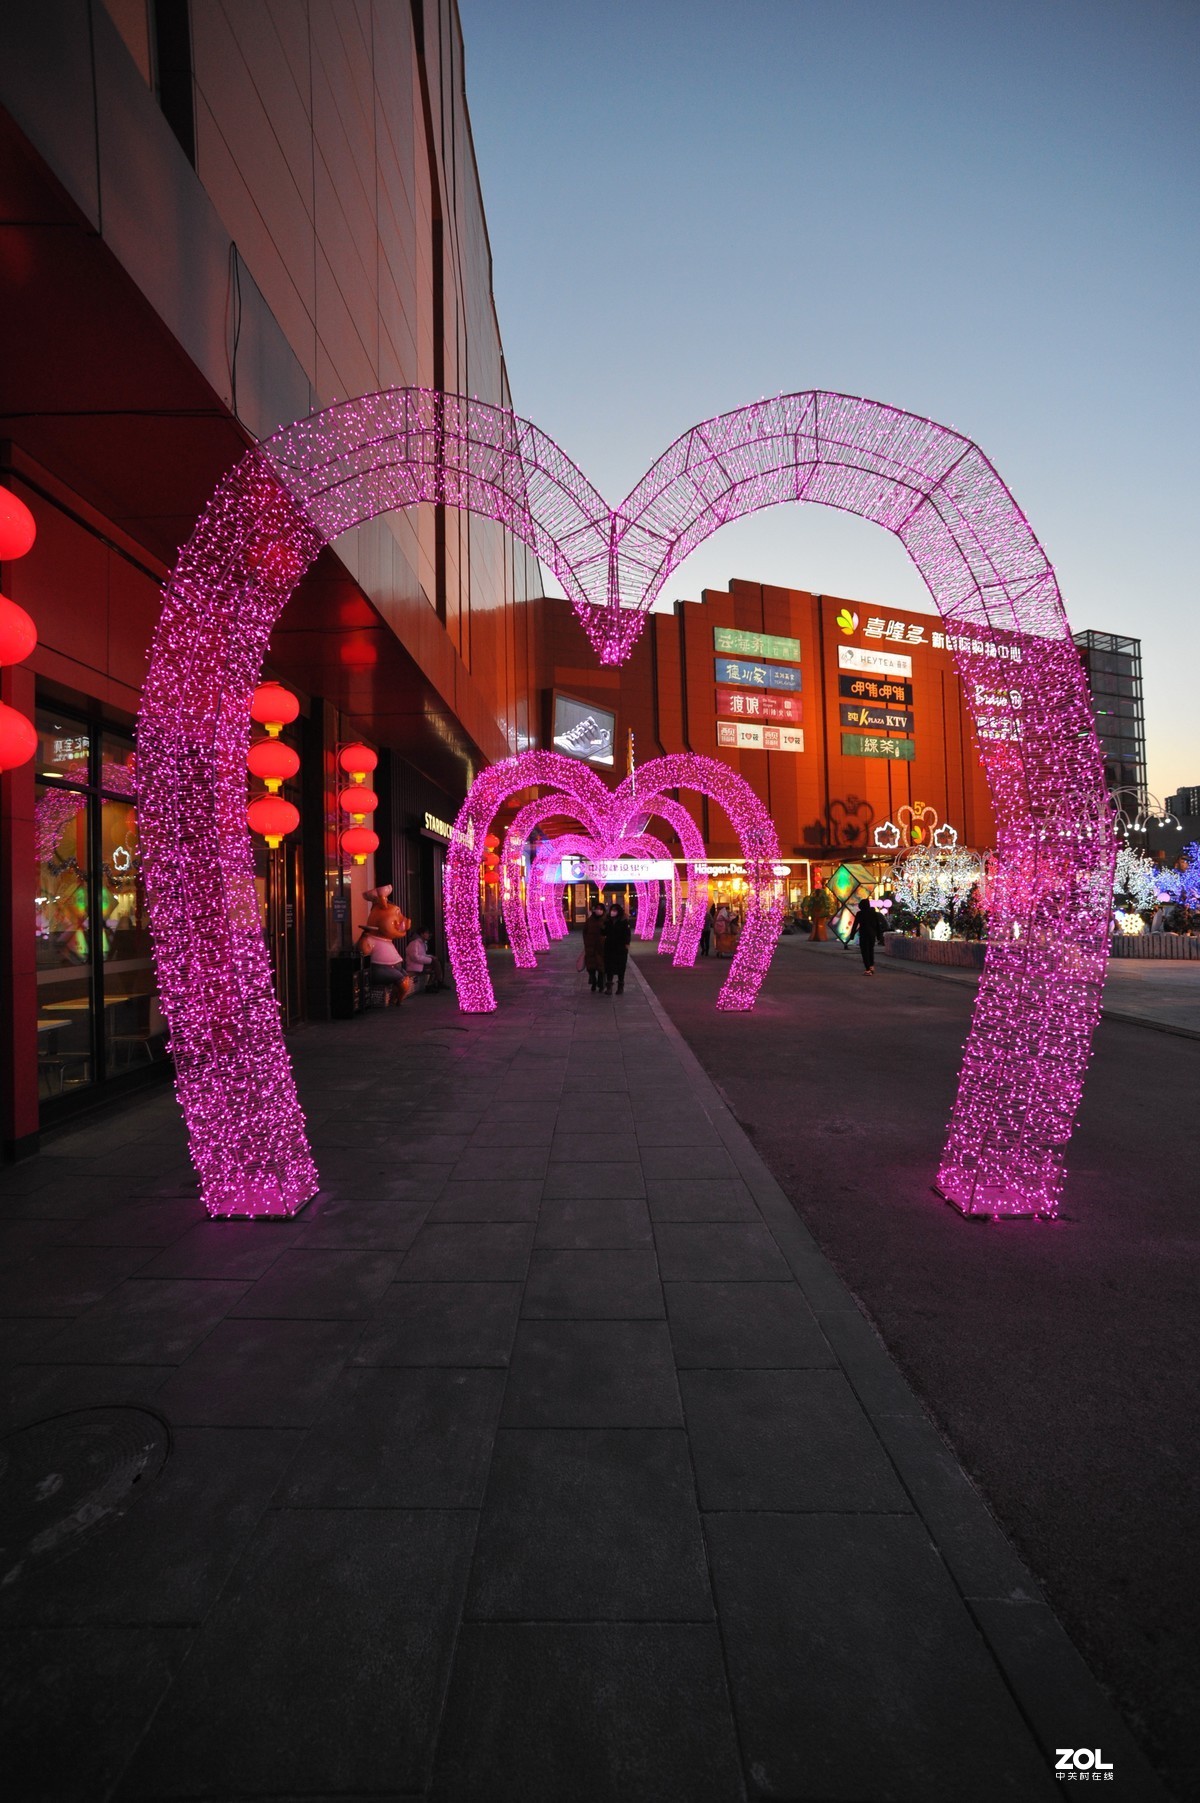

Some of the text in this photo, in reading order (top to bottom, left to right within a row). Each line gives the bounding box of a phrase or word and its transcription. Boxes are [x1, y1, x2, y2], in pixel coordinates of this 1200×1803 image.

[863, 617, 928, 645] 喜隆多
[718, 634, 764, 654] 云海肴
[860, 655, 894, 667] HEYTEA
[726, 664, 767, 684] 德川家
[851, 681, 905, 701] 呷哺呷哺
[730, 695, 760, 714] 渡娘
[886, 715, 908, 728] KTV
